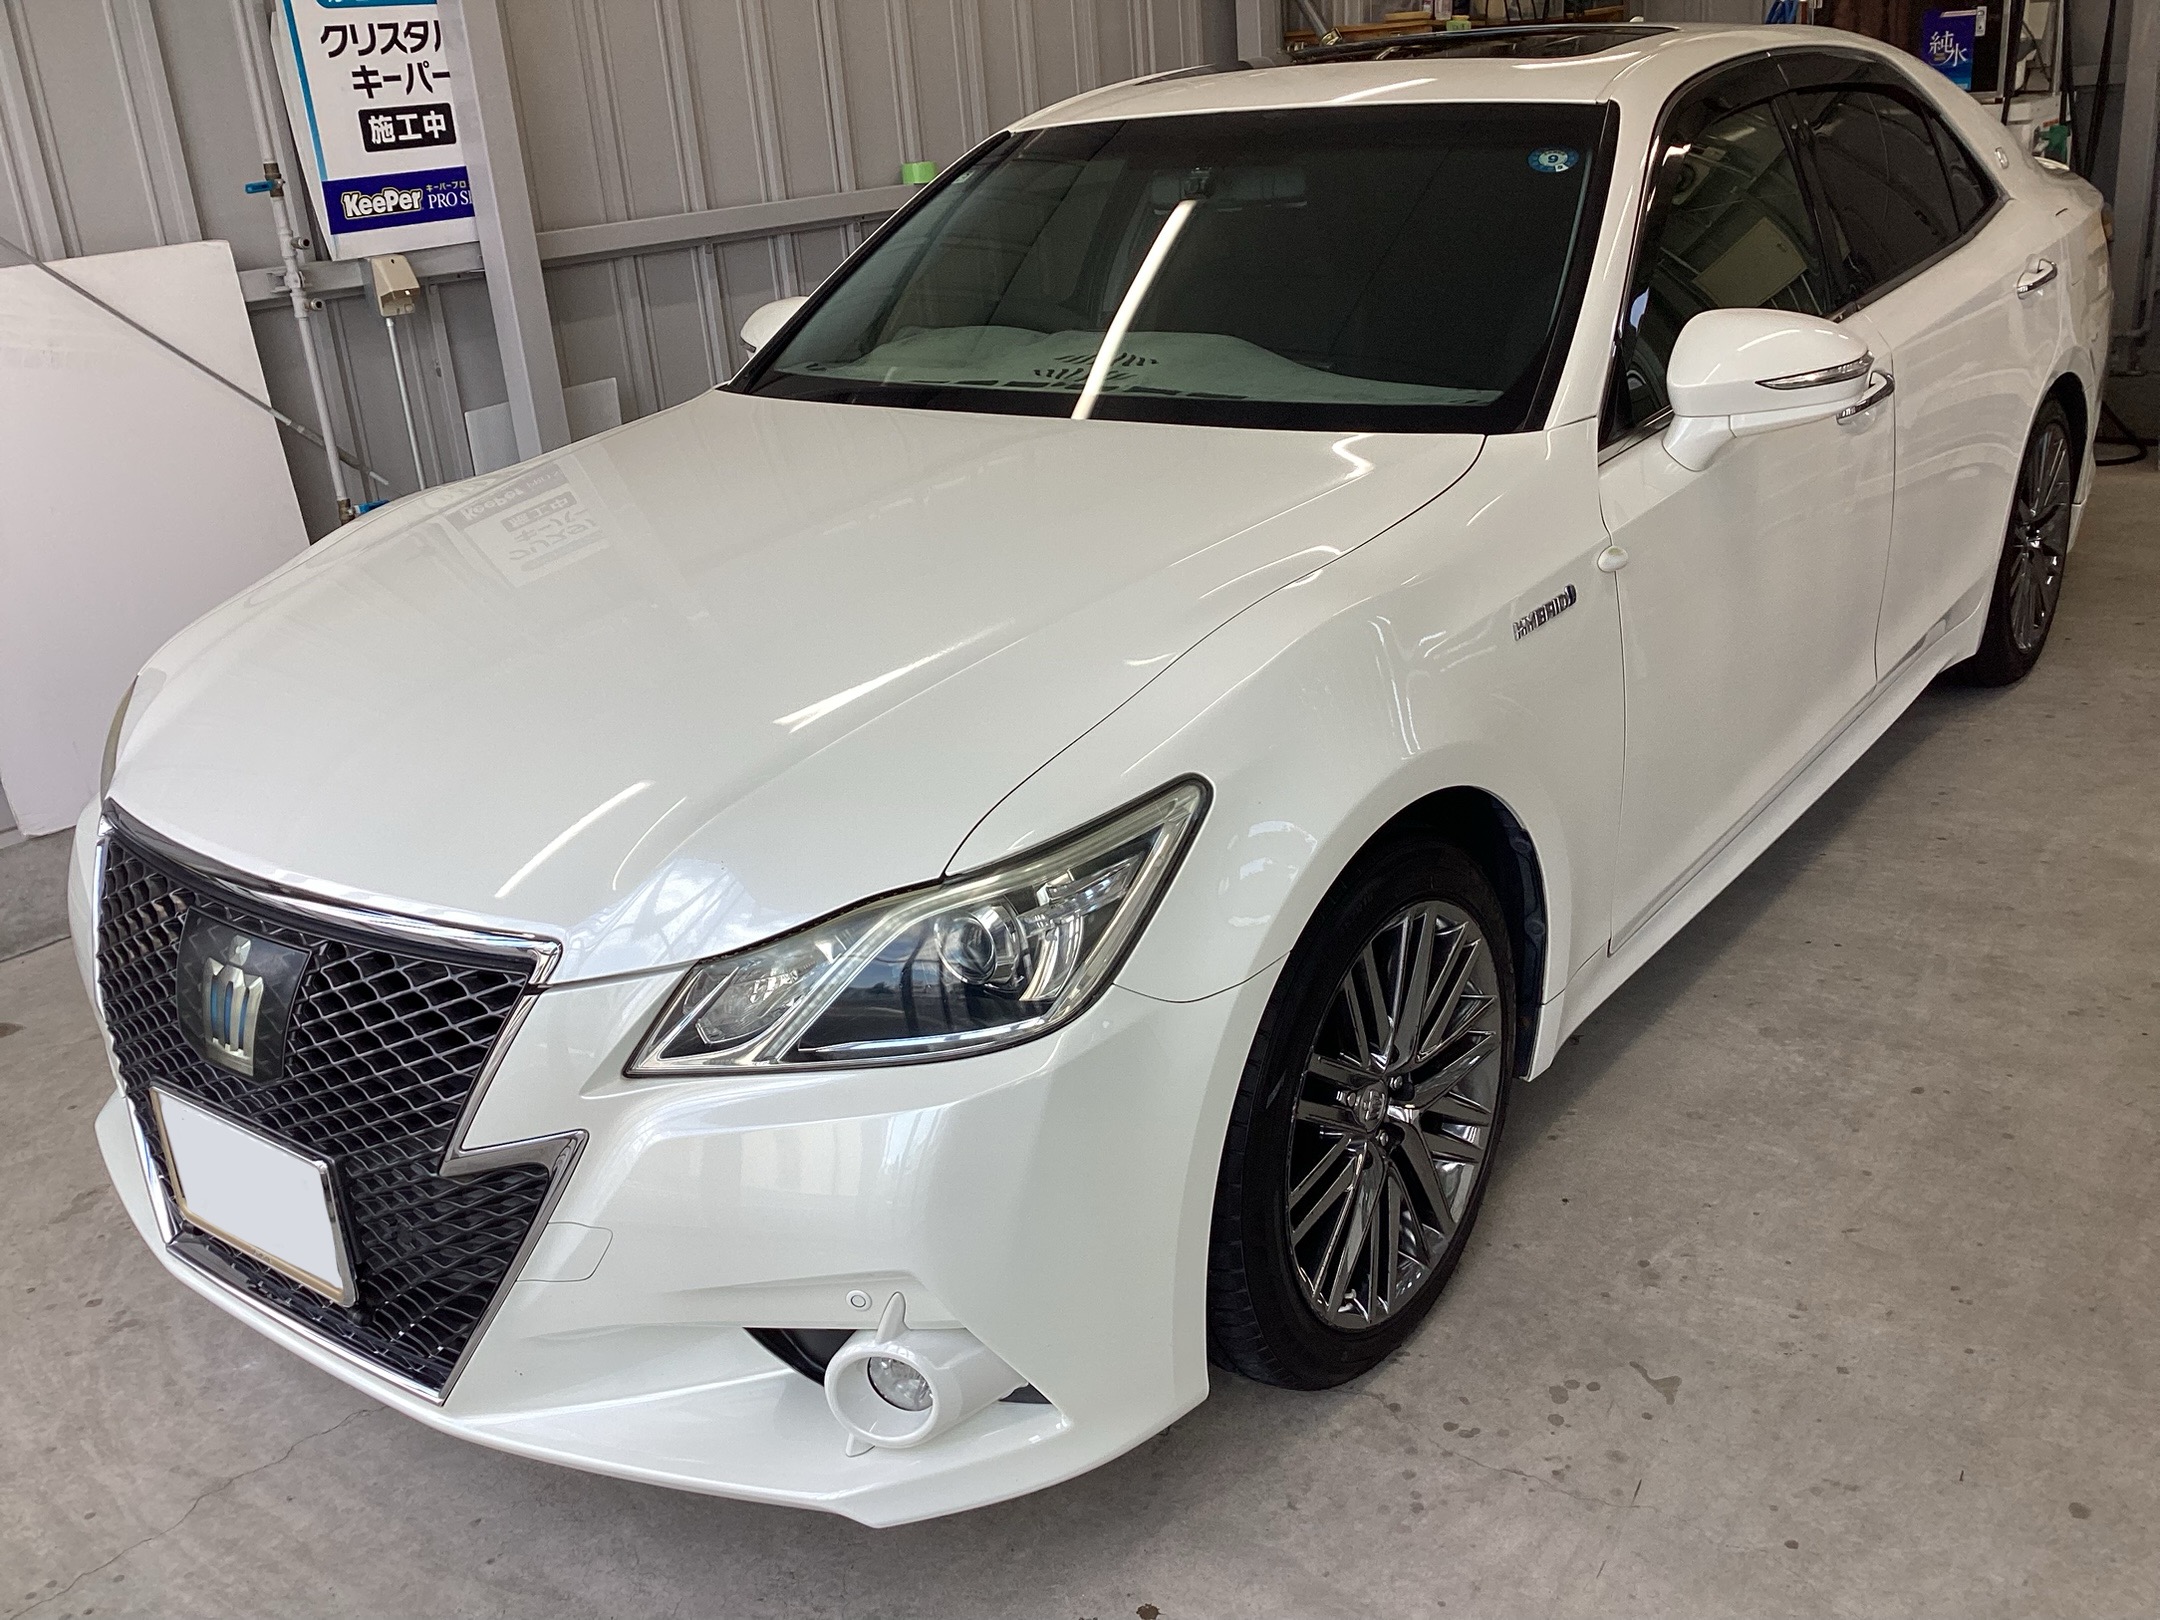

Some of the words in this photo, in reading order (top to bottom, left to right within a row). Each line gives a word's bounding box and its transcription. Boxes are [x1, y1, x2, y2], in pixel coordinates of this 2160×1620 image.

[1928, 30, 1968, 67] 純水
[352, 61, 450, 99] キーパー
[368, 110, 447, 144] 施工中
[342, 187, 422, 219] KeePer
[428, 192, 457, 209] PRO
[1513, 592, 1569, 641] HYBRID
